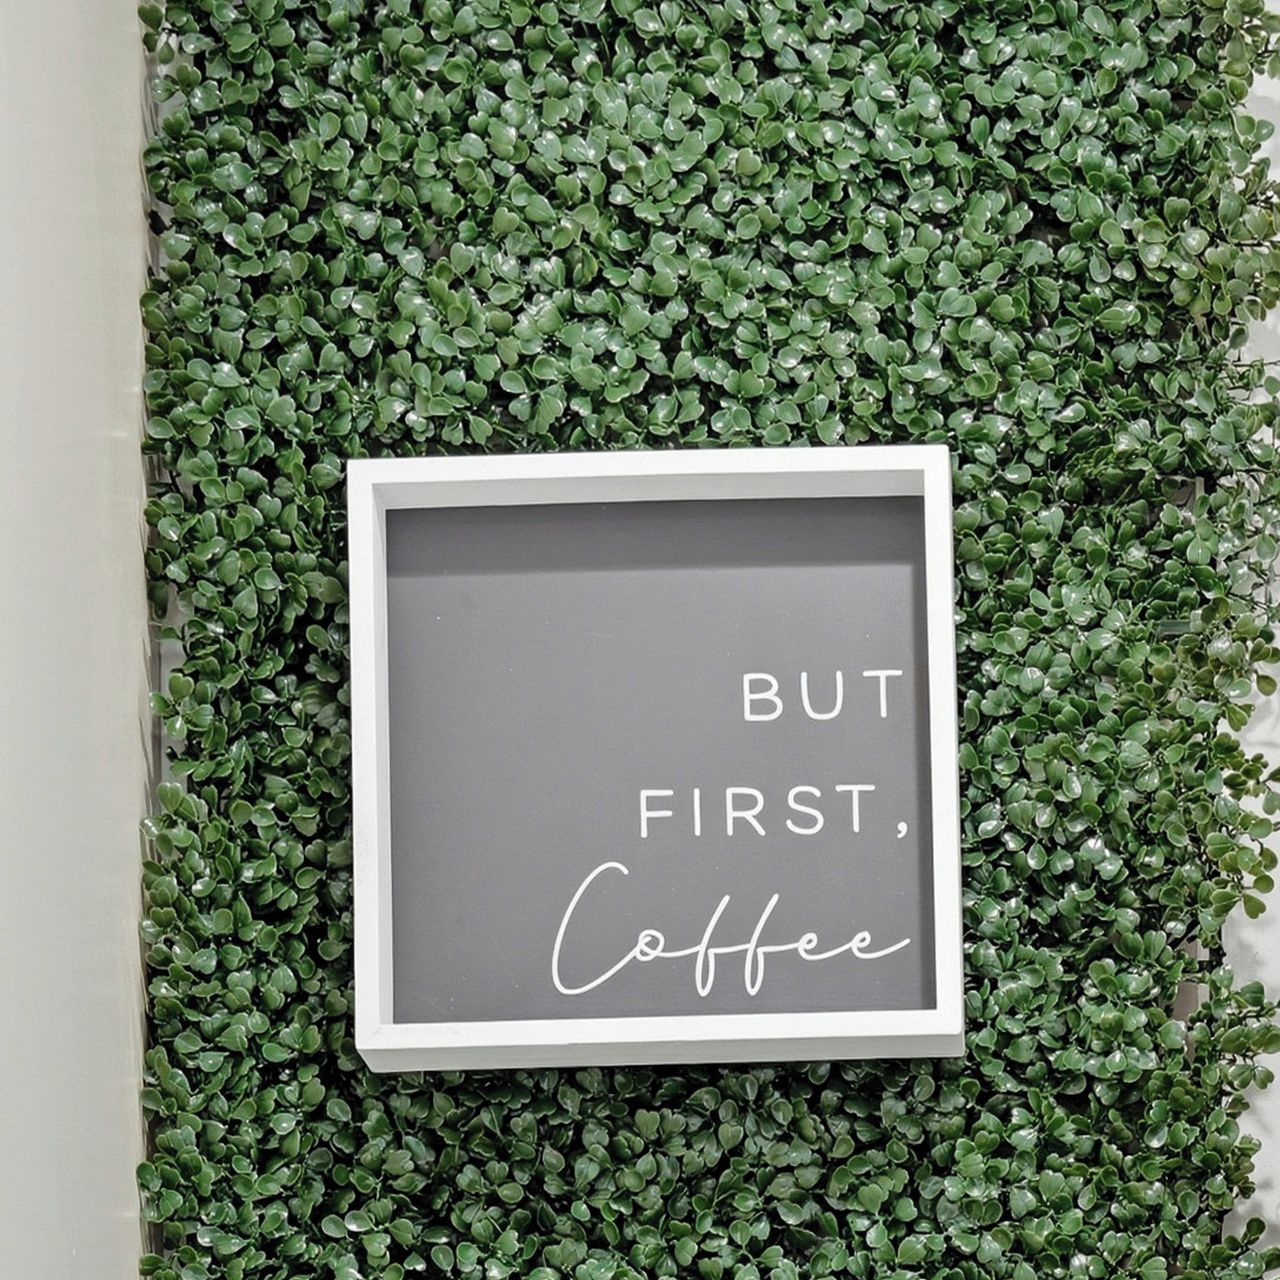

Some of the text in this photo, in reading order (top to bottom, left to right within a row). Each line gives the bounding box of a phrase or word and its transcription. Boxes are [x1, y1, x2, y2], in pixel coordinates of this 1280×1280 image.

[742, 669, 903, 721] BUT
[639, 784, 908, 838] FIRST,
[552, 861, 911, 997] Coffee
